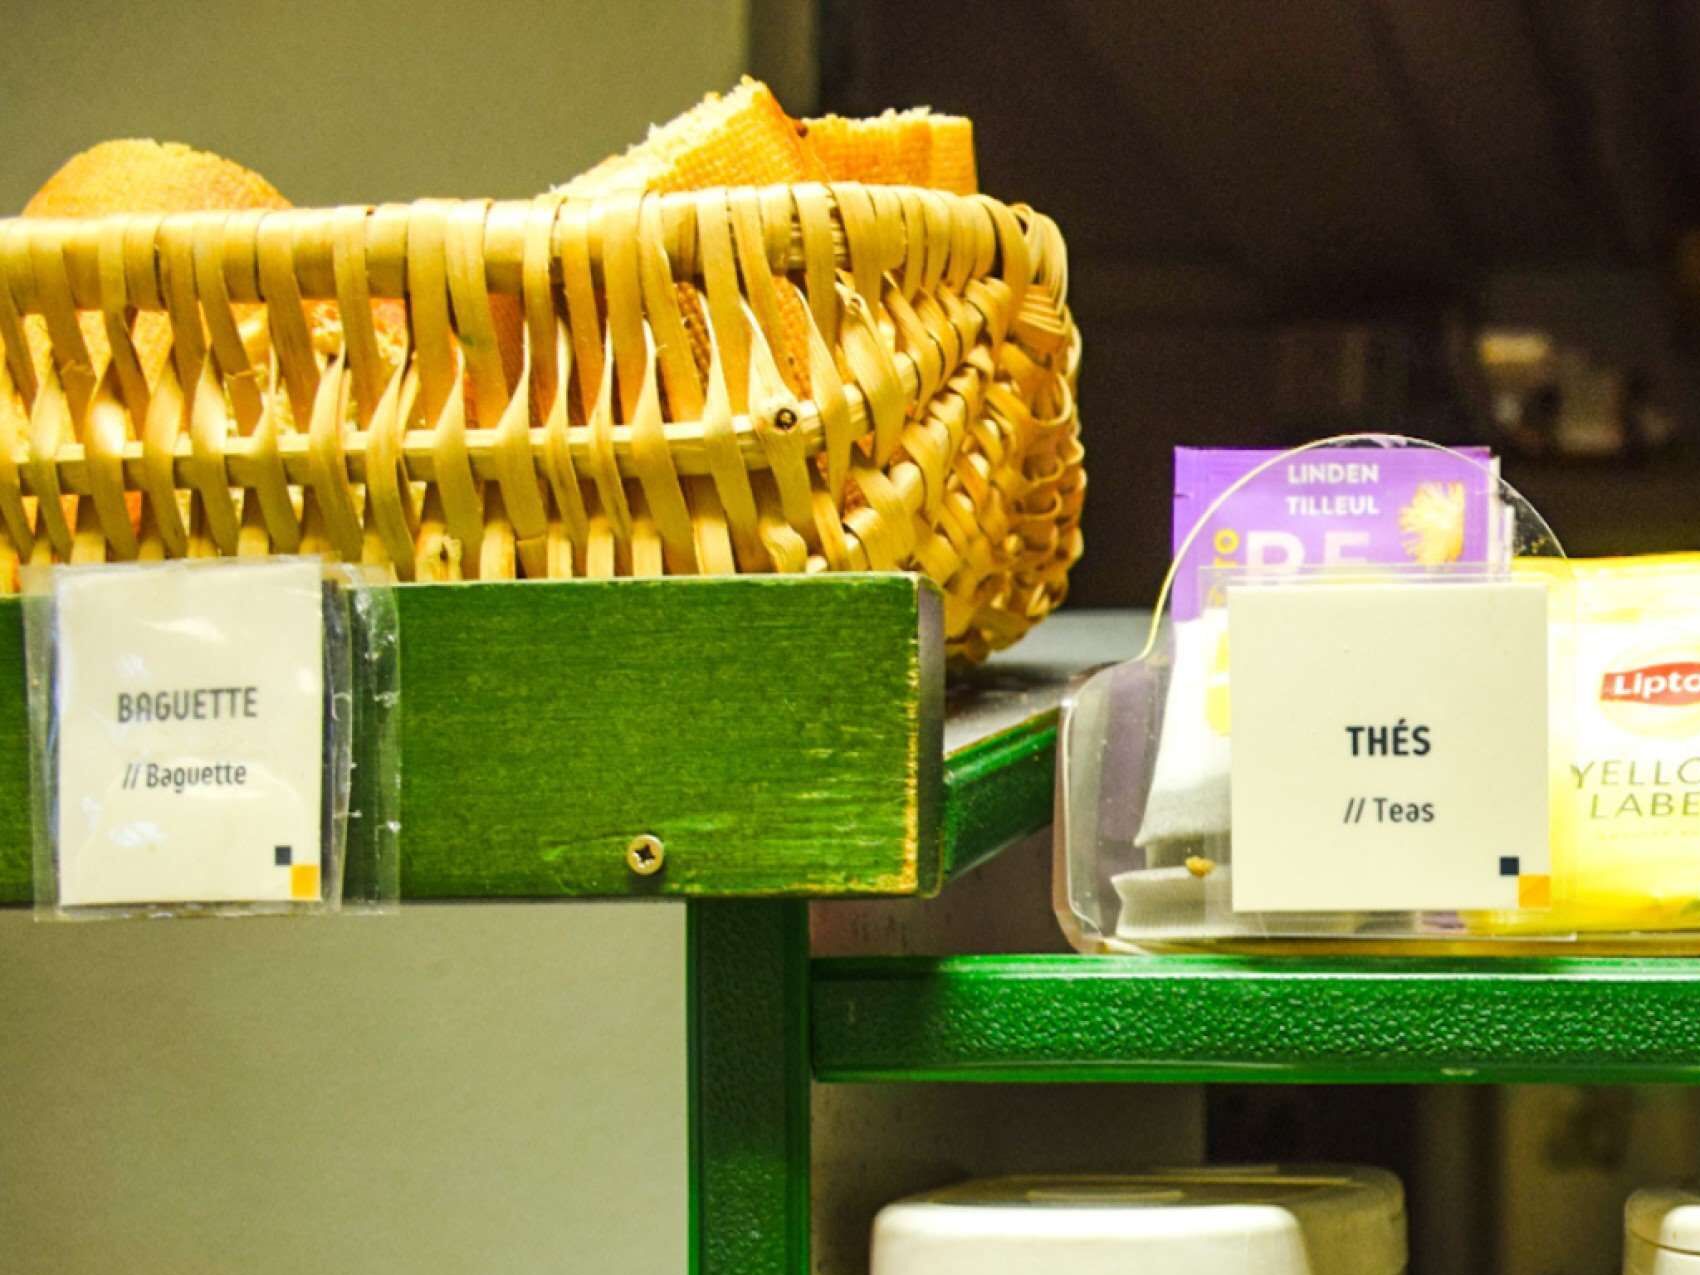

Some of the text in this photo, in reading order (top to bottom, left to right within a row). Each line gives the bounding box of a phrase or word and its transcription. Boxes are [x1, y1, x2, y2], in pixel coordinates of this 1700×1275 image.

[1287, 463, 1380, 485] LINDEN
[1287, 495, 1380, 517] TILLEUL
[117, 686, 258, 724] BAGUETTE
[1344, 717, 1432, 757] THÉS
[146, 761, 248, 795] Baguette
[1372, 797, 1436, 823] Teas
